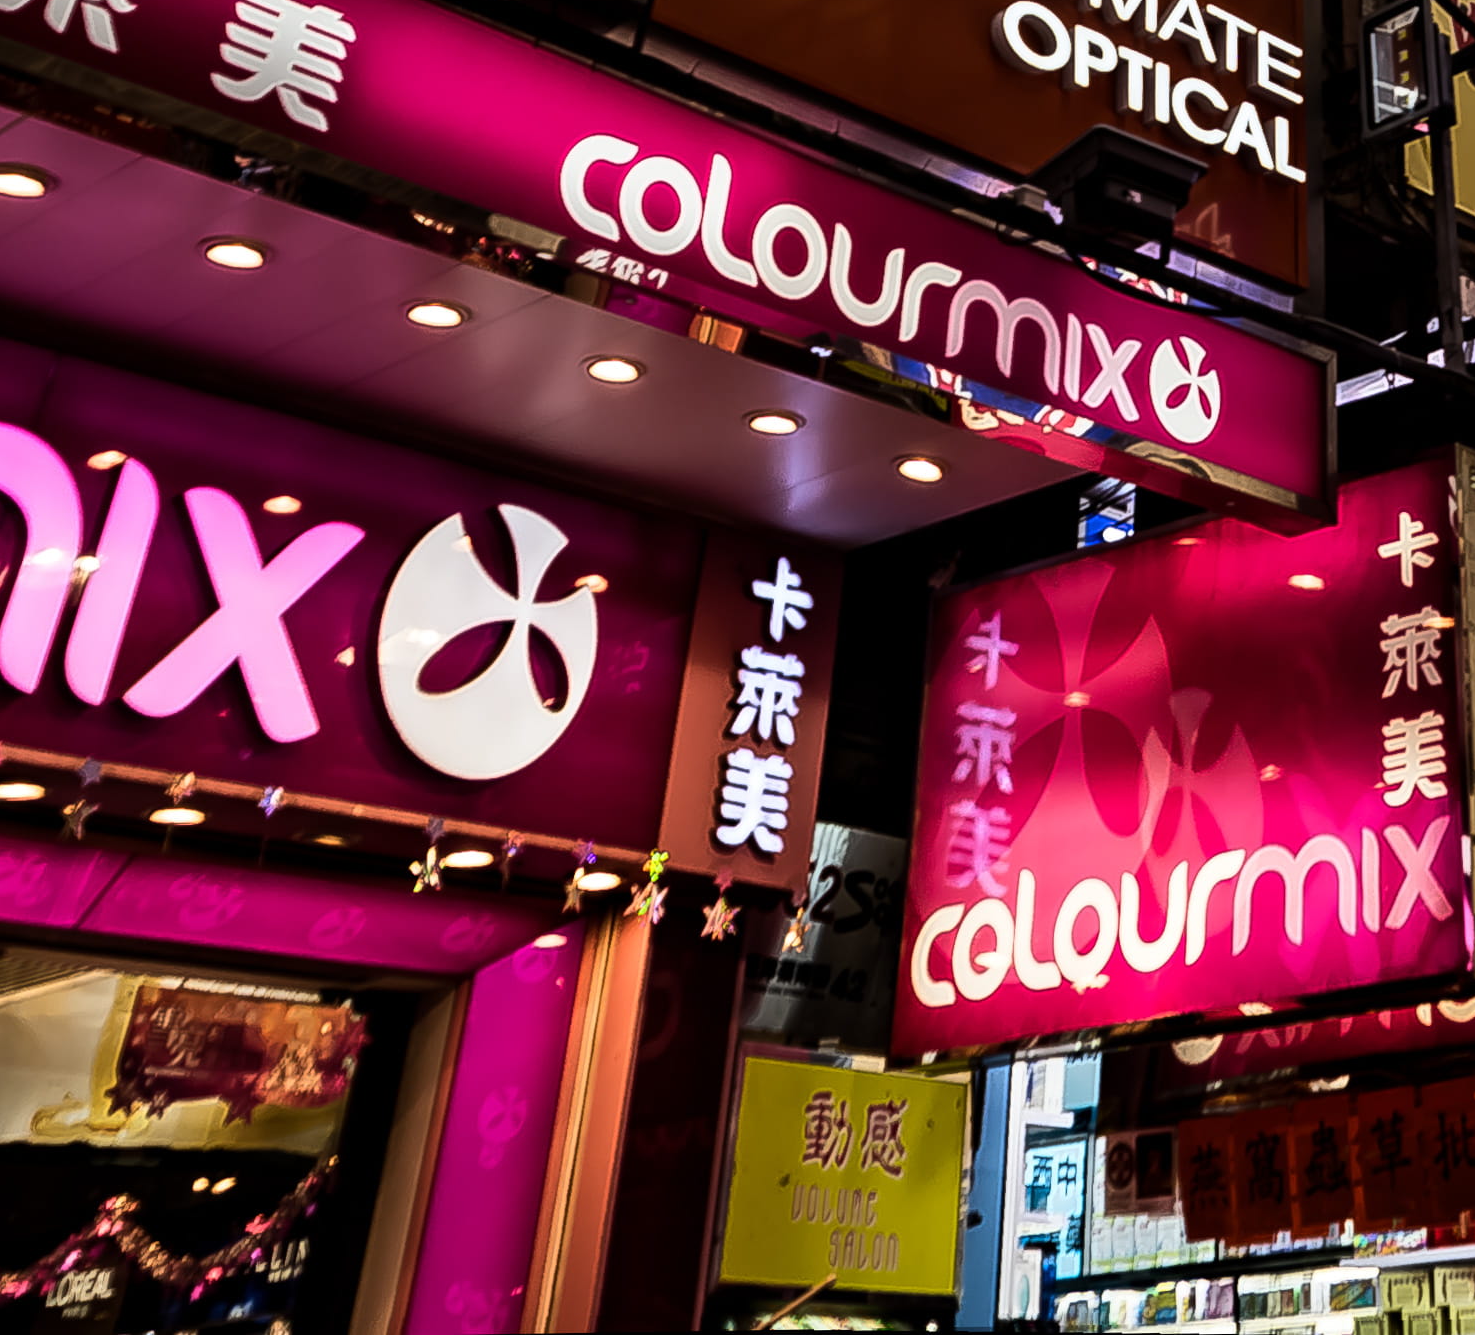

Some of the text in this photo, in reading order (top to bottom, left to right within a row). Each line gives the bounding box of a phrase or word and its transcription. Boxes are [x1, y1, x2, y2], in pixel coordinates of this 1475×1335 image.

[996, 0, 1307, 183] OPTICAL
[715, 555, 815, 856] 卡萊美
[1378, 511, 1450, 807] 卡萊美
[801, 1089, 909, 1179] 動感
[828, 1230, 900, 1273] SALON
